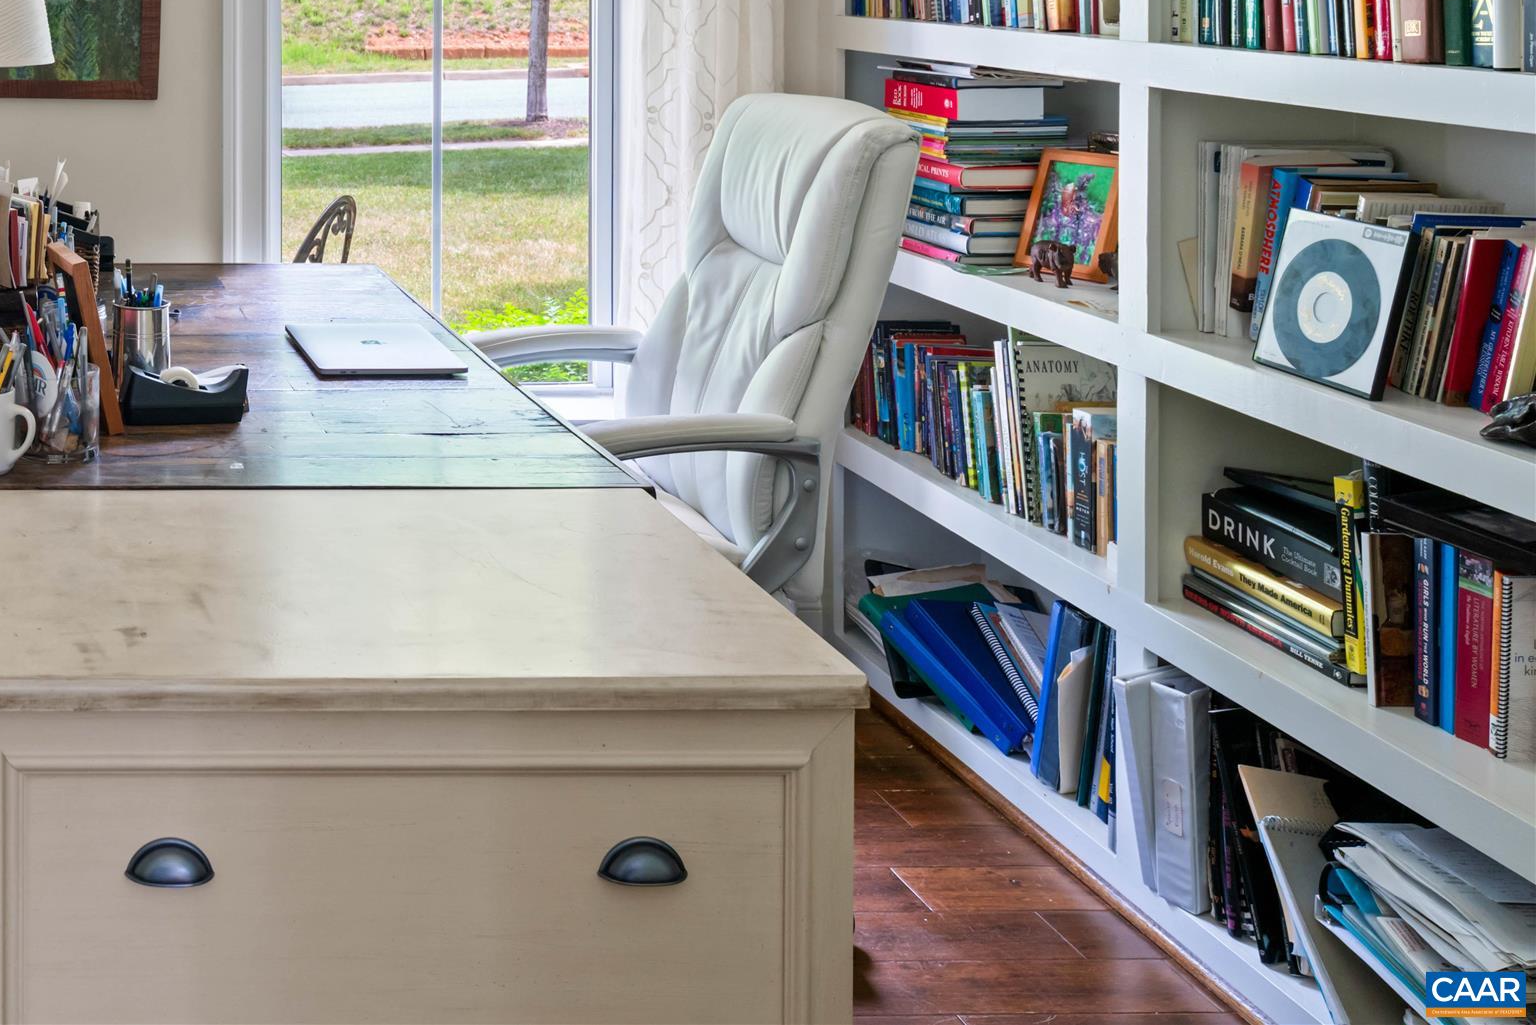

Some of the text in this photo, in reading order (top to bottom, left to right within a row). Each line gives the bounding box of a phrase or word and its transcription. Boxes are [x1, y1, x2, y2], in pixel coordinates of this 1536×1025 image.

[1258, 178, 1282, 275] ATMOSPHERE
[1399, 291, 1420, 353] ROETHKE
[1026, 360, 1079, 373] ANATOMY
[1478, 330, 1496, 394] MY GRANDFATHER'S
[1492, 320, 1514, 395] KITCHEN TABLE WISDOM
[1078, 452, 1087, 486] HOST
[1207, 508, 1276, 560] DRINK
[1340, 507, 1352, 566] Gardening
[1188, 547, 1234, 577] Harold Evans
[1281, 554, 1318, 577] Cocktail Book
[1282, 546, 1317, 568] The Ultimate
[1238, 572, 1313, 618] They Made America
[1344, 574, 1356, 629] Dummies
[1471, 597, 1480, 642] LITERATURE
[1289, 645, 1324, 669] BILL YENNE
[1472, 646, 1478, 655] BY
[1515, 655, 1525, 663] in
